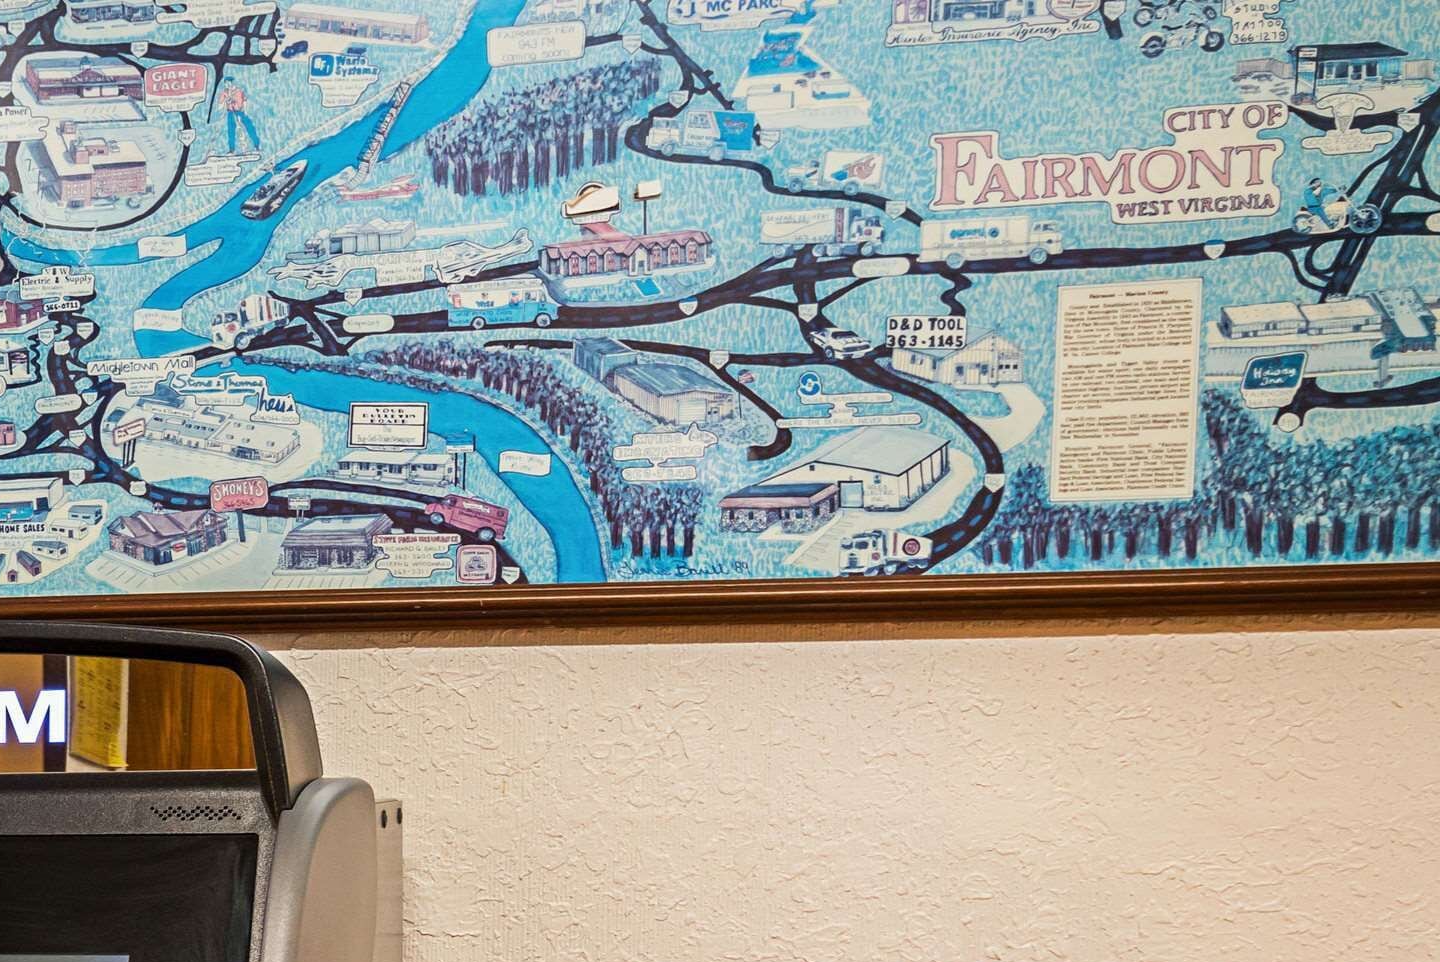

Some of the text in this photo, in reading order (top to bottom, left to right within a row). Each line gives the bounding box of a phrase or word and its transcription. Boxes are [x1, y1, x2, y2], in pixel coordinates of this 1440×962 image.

[152, 70, 196, 82] GIANT
[153, 80, 196, 91] EAGLE
[5, 108, 27, 116] Power
[1167, 104, 1283, 133] CITY OF
[934, 134, 1277, 206] FAIRMONT
[1116, 194, 1276, 218] WEST VIRGINIA
[65, 276, 92, 285] Supply
[928, 317, 964, 331] TOOL
[887, 335, 963, 347] 363-1145
[90, 358, 194, 375] Middletown Mall
[1260, 377, 1285, 386] Inn
[0, 524, 20, 534] HOME
[23, 523, 46, 533] SALES
